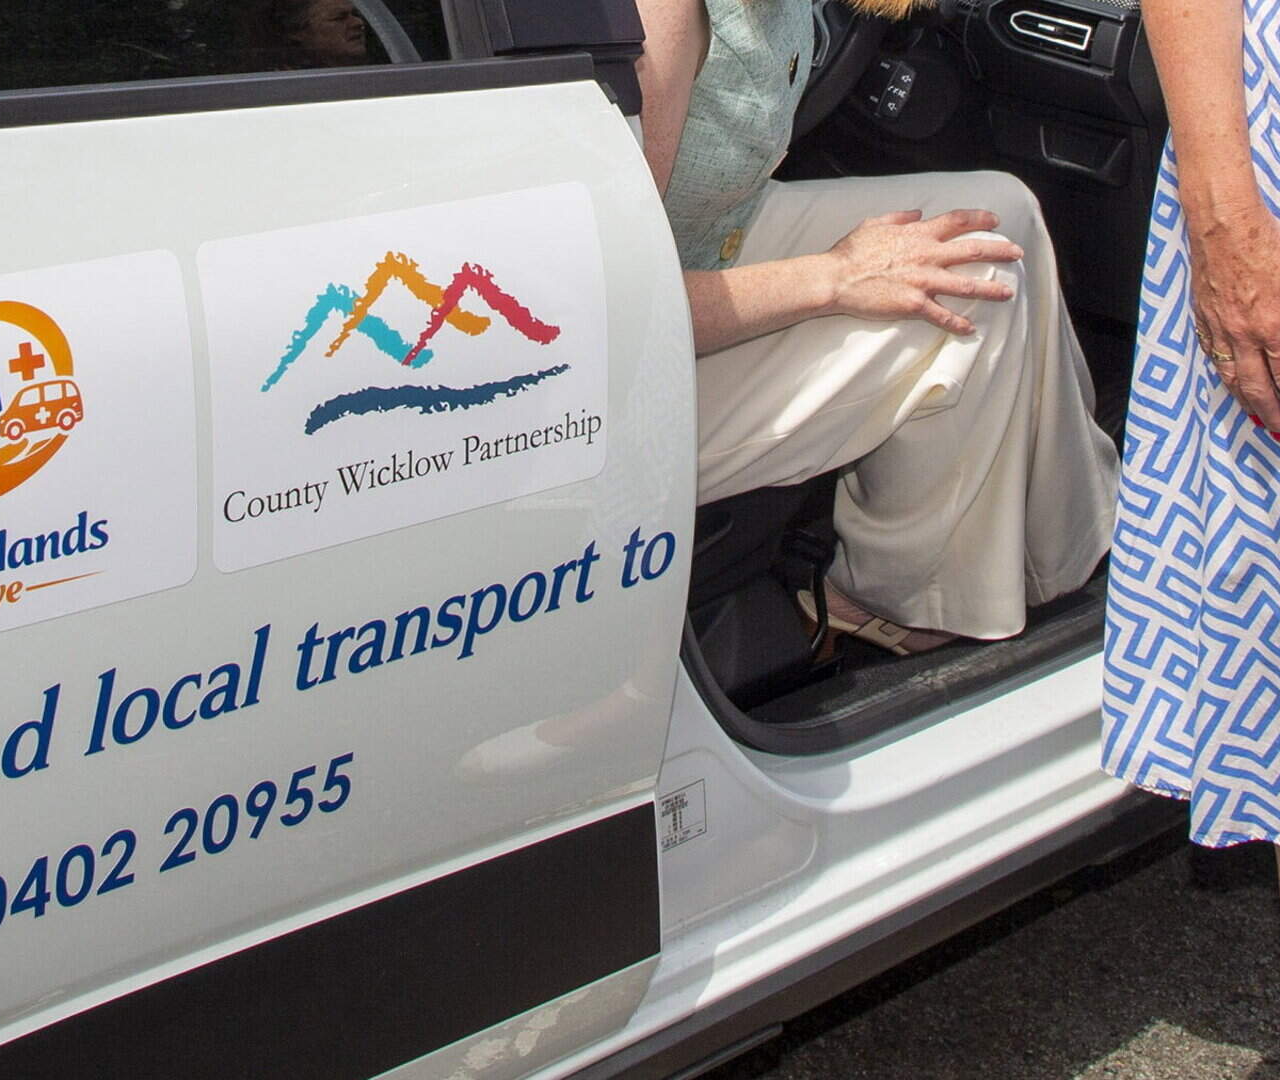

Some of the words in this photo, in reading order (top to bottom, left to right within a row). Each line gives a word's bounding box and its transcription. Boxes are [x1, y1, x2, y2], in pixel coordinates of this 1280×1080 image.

[223, 480, 329, 524] County
[337, 450, 456, 497] Wicklow
[462, 408, 602, 467] Partnership
[84, 624, 273, 757] local
[296, 541, 601, 692] transport
[620, 527, 676, 590] to
[159, 752, 355, 874] 20955
